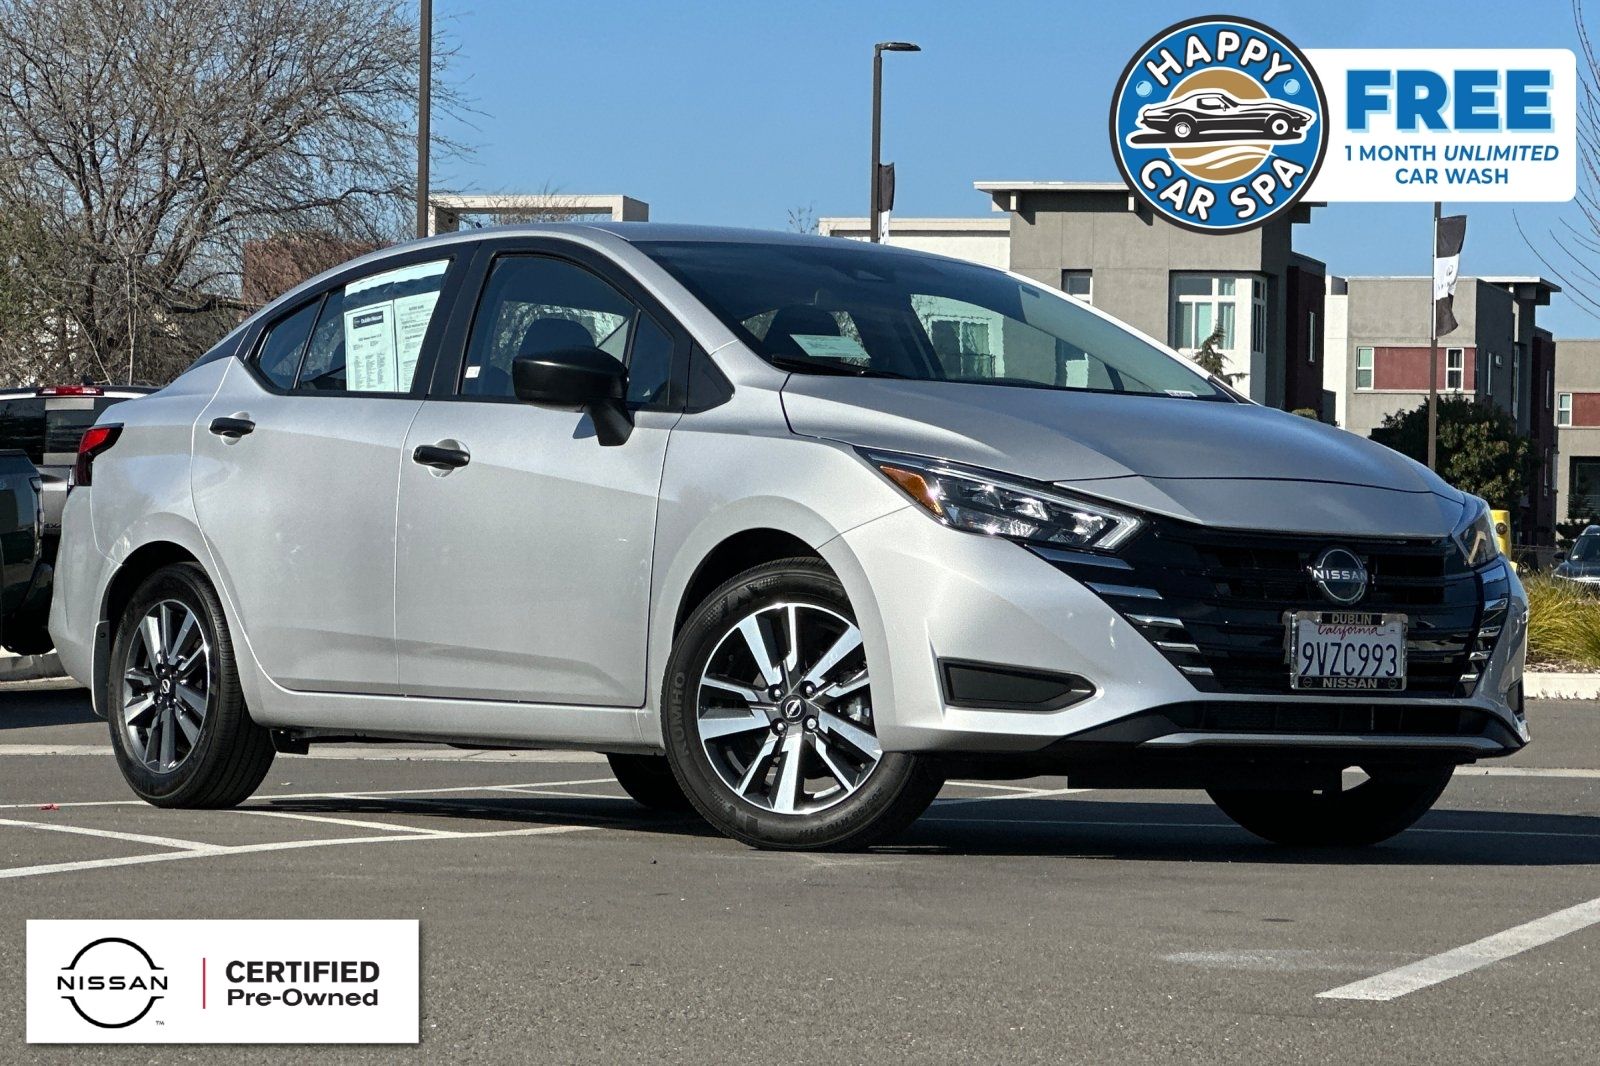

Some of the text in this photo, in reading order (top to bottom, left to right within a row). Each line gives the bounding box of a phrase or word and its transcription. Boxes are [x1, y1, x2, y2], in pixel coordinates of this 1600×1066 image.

[1312, 569, 1367, 580] NISSAN
[1331, 614, 1372, 625] DUBLIN
[1318, 624, 1384, 640] California
[1301, 642, 1397, 677] 9VZC993
[1322, 678, 1378, 688] NISSAN
